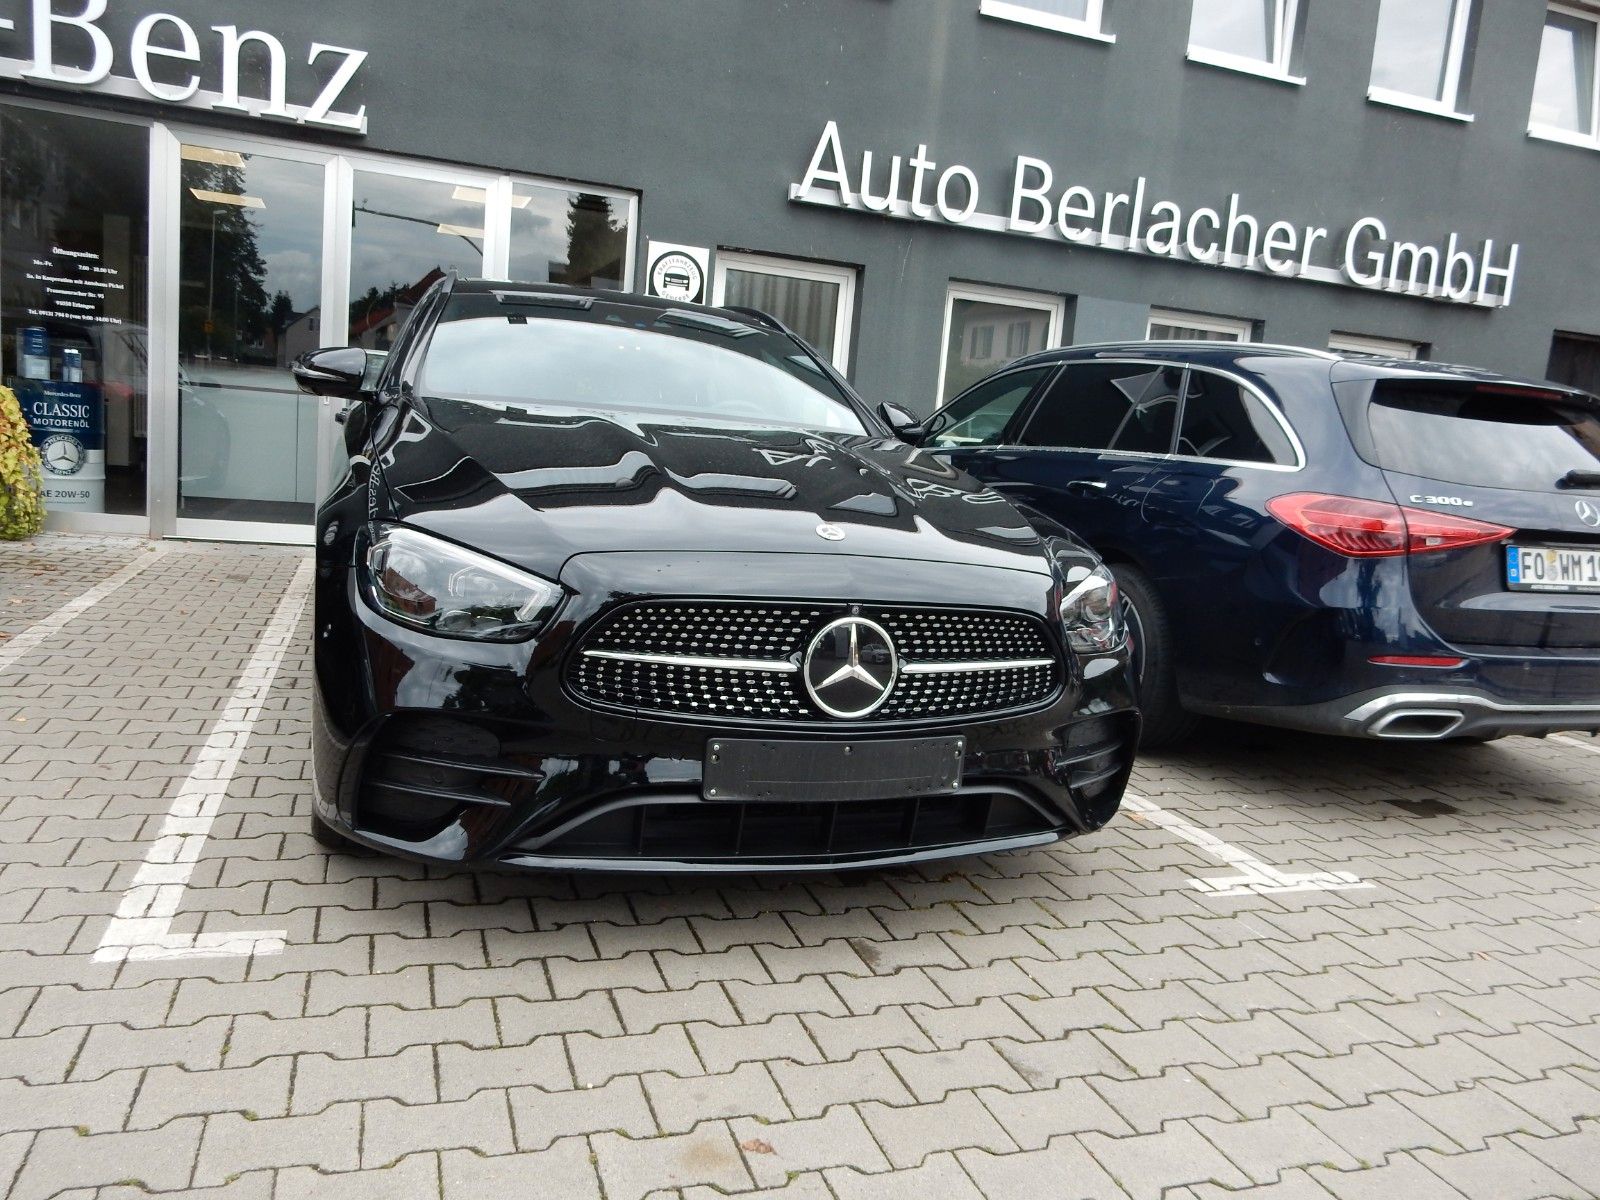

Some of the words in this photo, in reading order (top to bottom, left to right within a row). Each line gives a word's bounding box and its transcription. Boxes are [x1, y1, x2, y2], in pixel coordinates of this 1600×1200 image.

[797, 120, 979, 225] Auto
[1010, 155, 1328, 278] Berlacher
[1345, 216, 1520, 306] GmbH
[33, 401, 90, 418] CLASSIC
[32, 417, 90, 429] MOTORENÖL
[40, 489, 52, 498] AE
[54, 490, 90, 499] 20W-50
[1521, 552, 1545, 580] FO
[1559, 553, 1583, 582] WM
[1586, 554, 1600, 582] 1
